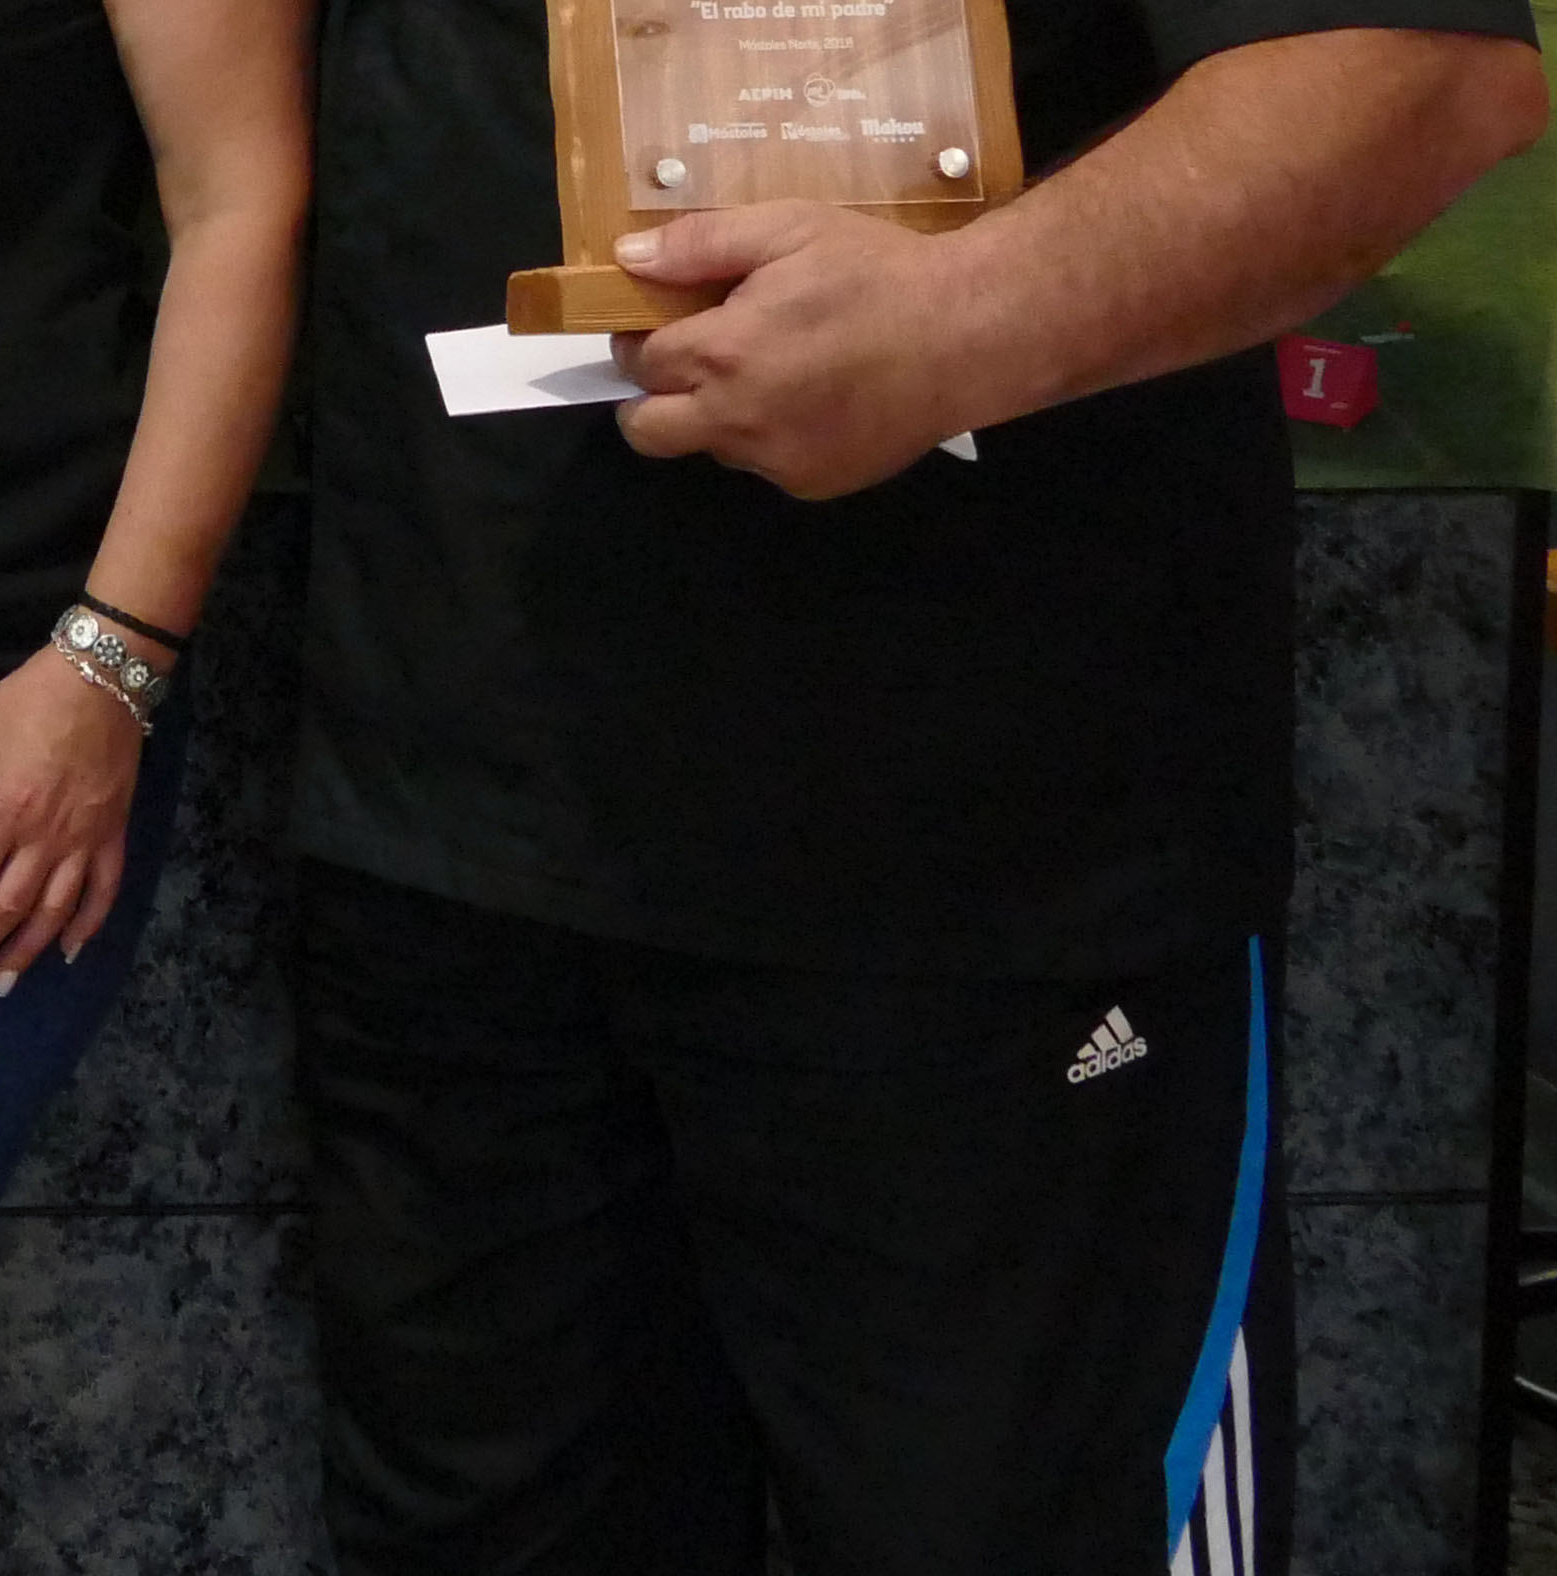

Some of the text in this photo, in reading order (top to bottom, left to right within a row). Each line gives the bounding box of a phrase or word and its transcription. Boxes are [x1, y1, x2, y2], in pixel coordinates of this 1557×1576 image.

[723, 0, 767, 18] rabo
[772, 1, 795, 18] de
[801, 0, 825, 17] mi
[1067, 1036, 1148, 1084] adidas
